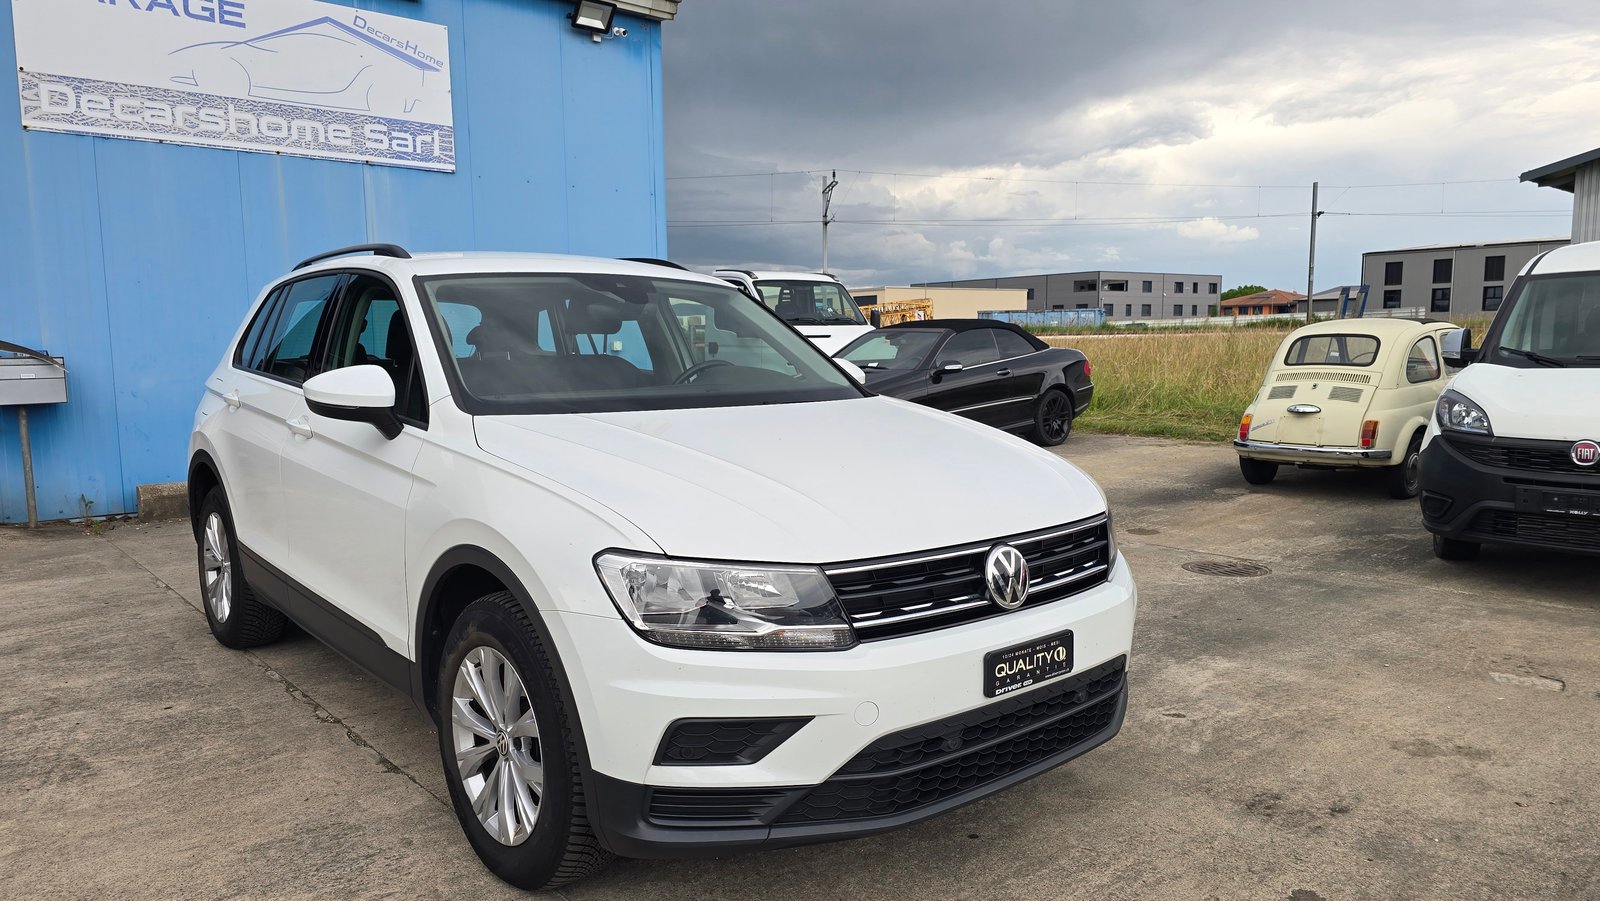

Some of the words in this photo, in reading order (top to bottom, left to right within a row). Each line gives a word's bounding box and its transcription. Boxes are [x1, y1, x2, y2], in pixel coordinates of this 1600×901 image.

[353, 15, 444, 68] DecarsHome
[38, 82, 352, 147] Decarshome
[363, 122, 441, 157] Sarl
[1577, 447, 1595, 460] FIAT
[995, 649, 1054, 678] QUALITY
